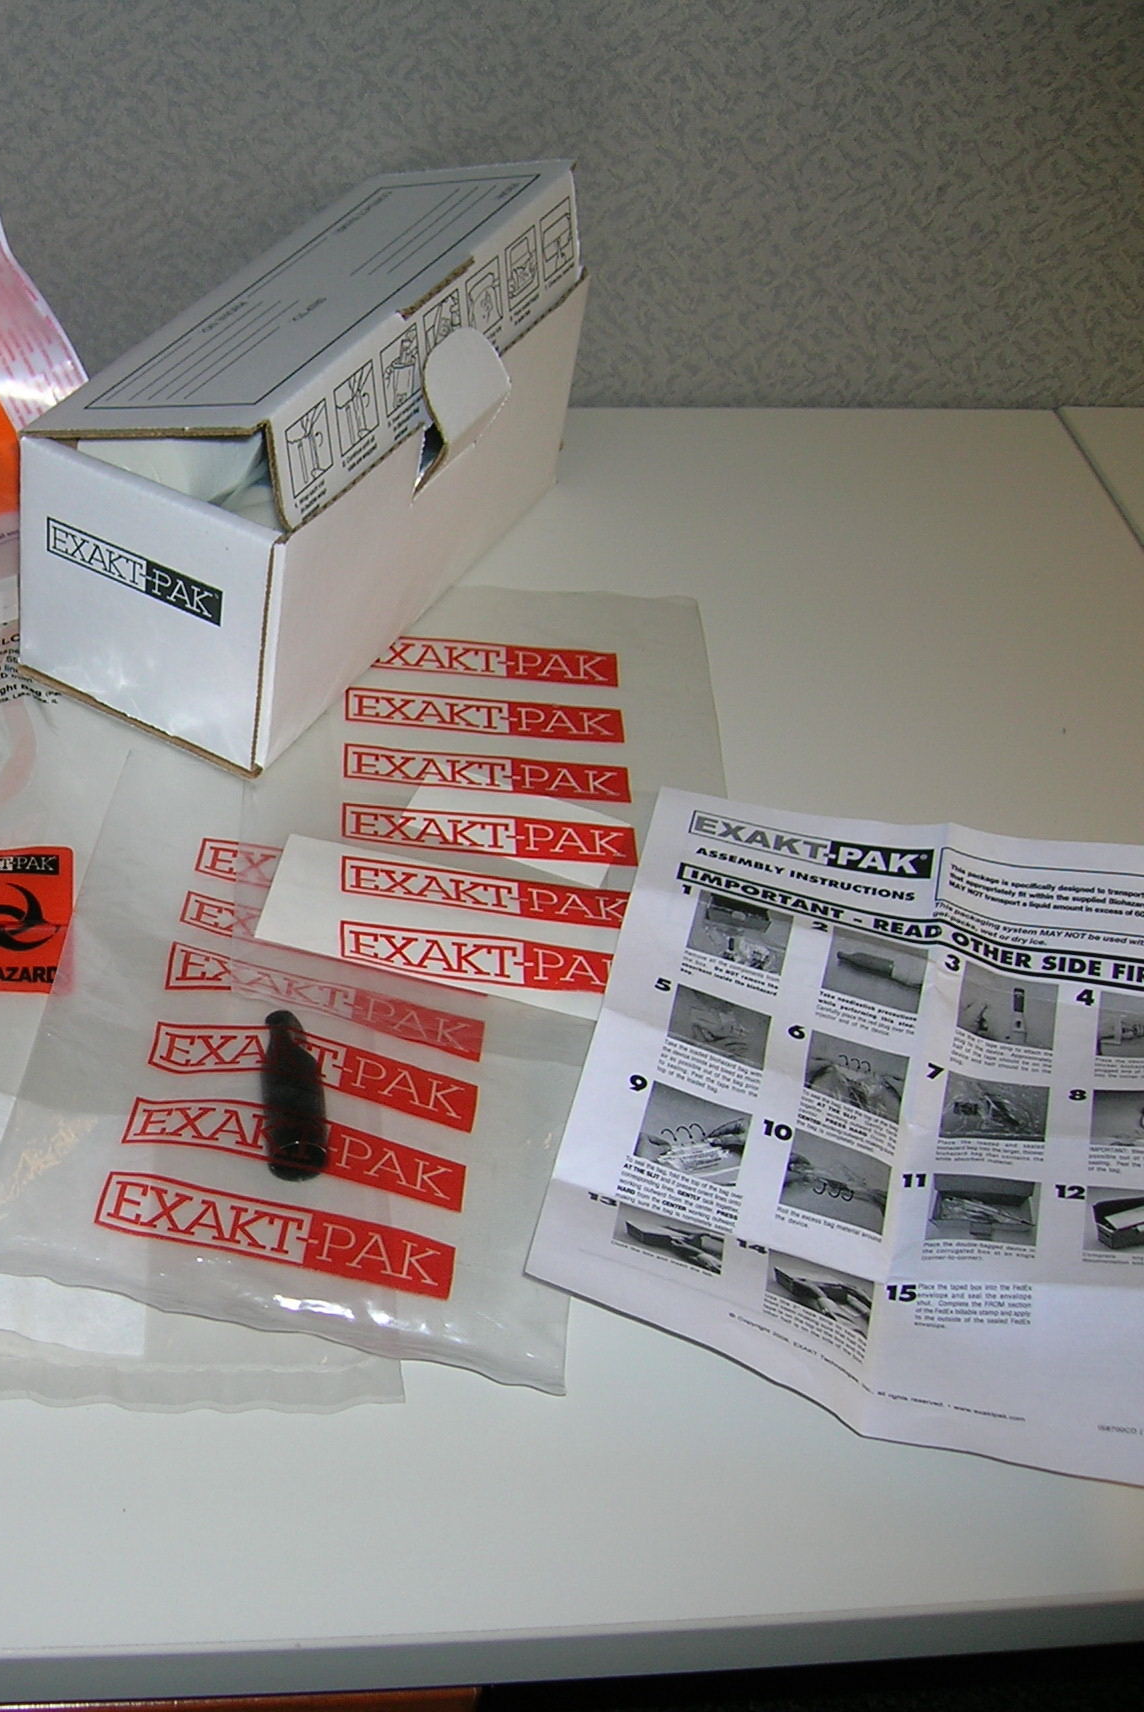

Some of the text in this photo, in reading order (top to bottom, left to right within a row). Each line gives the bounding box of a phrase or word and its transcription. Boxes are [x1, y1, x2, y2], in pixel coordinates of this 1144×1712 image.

[51, 526, 214, 618] EXAKT-PAK
[376, 643, 609, 681] XAKT-PAK
[21, 684, 42, 697] Bag
[353, 694, 615, 736] EXAKT-PAK
[352, 751, 620, 796] EXAKT-PAK
[350, 811, 626, 858] EXAKT-PAK
[696, 847, 916, 902] ASSEMBLY INSTRUCTIONS
[350, 866, 628, 922] EXAKT-PAK
[1053, 903, 1123, 916] amount excess
[690, 869, 846, 919] IMPORTANT
[872, 917, 943, 939] READ
[951, 932, 1032, 969] OTHER
[1041, 955, 1102, 977] SIDE
[812, 921, 830, 933] 2
[1011, 935, 1027, 945] dry
[1039, 929, 1063, 938] MAY
[1064, 931, 1087, 939] NOT
[1102, 935, 1128, 944] used
[349, 931, 612, 987] EXAKT-PA
[944, 954, 960, 972] 3
[654, 977, 672, 992] 5
[178, 948, 467, 1053] EXAKT-PAK
[1076, 988, 1095, 1006] 4
[787, 1024, 806, 1040] 6
[161, 1032, 462, 1120] EXAT-PAK
[926, 1062, 944, 1080] 7
[629, 1074, 648, 1092] 9
[1068, 1089, 1087, 1101] 8
[763, 1119, 793, 1141] 10
[902, 1173, 927, 1188] 11
[1056, 1184, 1086, 1200] 12
[108, 1182, 440, 1287] EXAKT-PAK
[886, 1284, 916, 1301] 15
